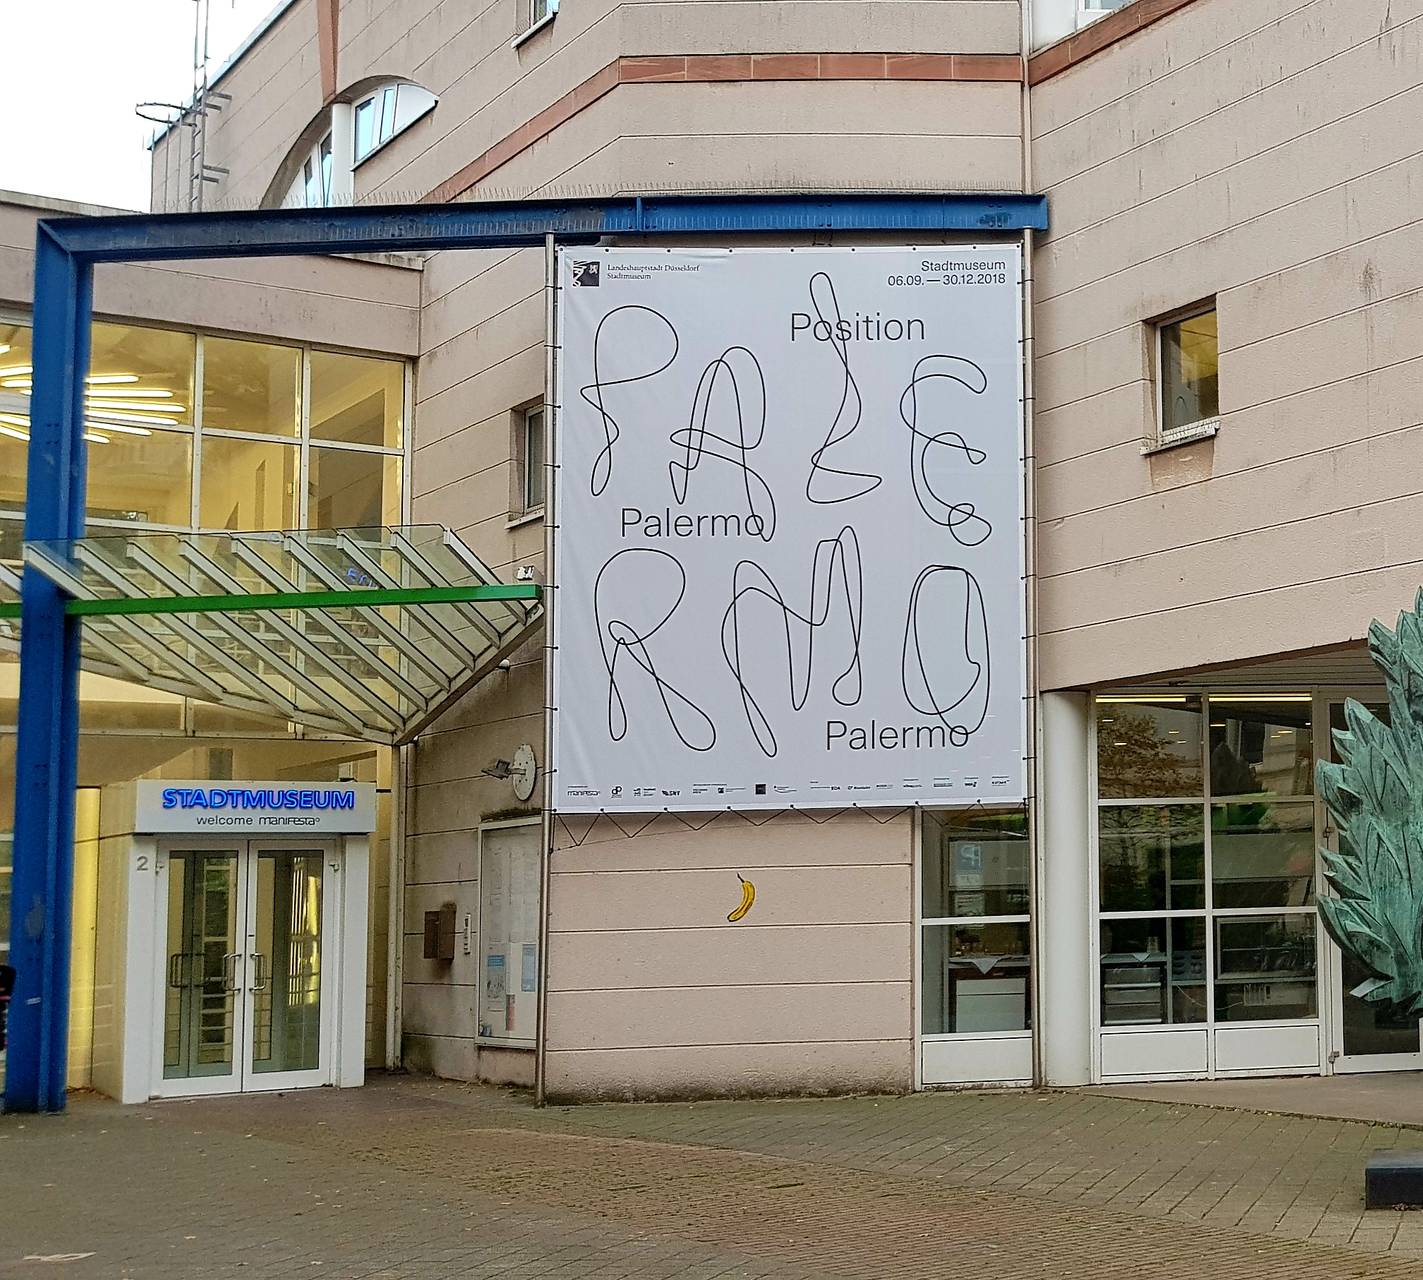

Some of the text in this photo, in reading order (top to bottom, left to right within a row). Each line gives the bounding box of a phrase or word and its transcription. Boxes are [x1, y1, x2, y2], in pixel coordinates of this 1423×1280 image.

[921, 260, 1006, 272] Stadtmuseum
[607, 272, 652, 280] Stadtmuseum
[887, 275, 924, 287] 06.09.
[943, 273, 1006, 286] 30.12.2018
[791, 311, 925, 342] Position
[621, 507, 764, 538] Palermo
[826, 720, 969, 751] Palermo
[162, 788, 355, 809] STADTMUSEUM
[196, 815, 253, 826] welcome
[136, 856, 149, 871] 2
